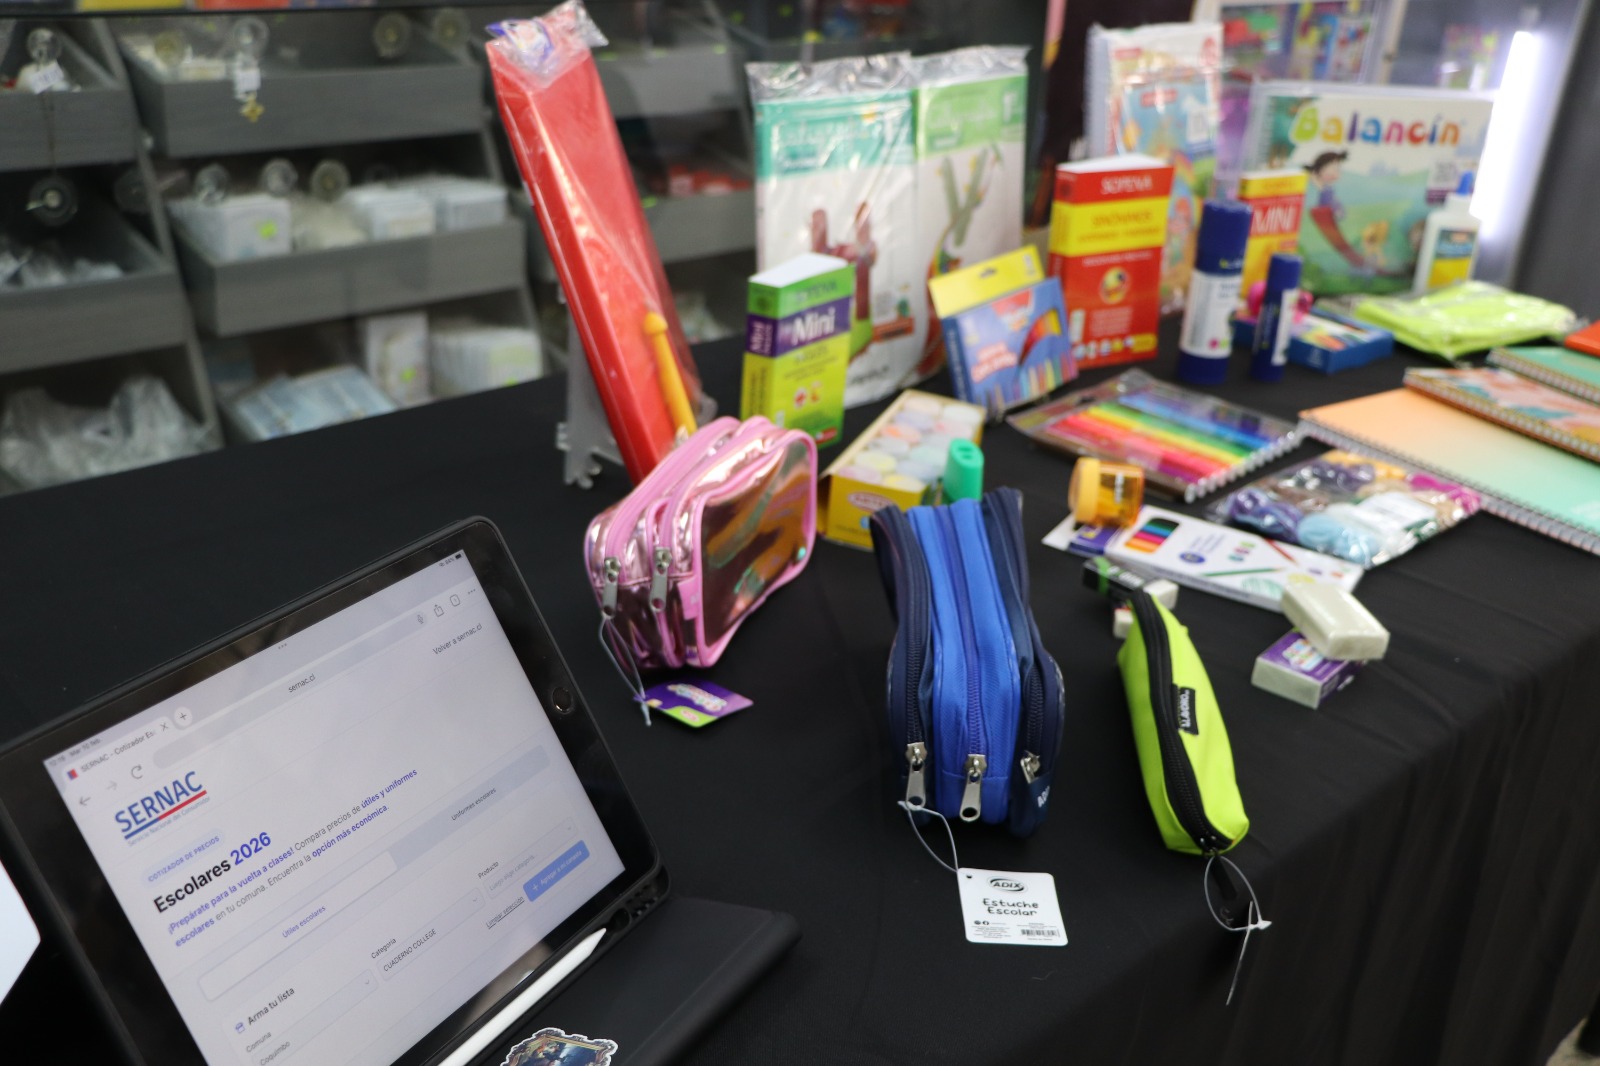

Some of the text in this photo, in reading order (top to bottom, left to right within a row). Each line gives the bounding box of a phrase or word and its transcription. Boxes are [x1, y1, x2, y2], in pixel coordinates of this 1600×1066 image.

[791, 307, 836, 346] Mini
[432, 640, 452, 655] Volver
[457, 623, 482, 642] sernac.cl
[288, 673, 316, 693] sernac.cl
[80, 753, 109, 773] SERNAC
[114, 734, 145, 756] Cotizador
[115, 771, 203, 833] SERNAC
[451, 788, 496, 821] Uniformes escolares
[148, 836, 220, 882] COTIZADOR DE PRECIOS
[168, 769, 418, 935] ¡Prepárate para la vuelta a clases! Compara precios de útiles y uniformes
[153, 832, 271, 914] Escolares 2026
[175, 804, 389, 947] escolares en tu comuna. Encuentra la opción más económica.
[478, 861, 499, 879] Producto
[993, 881, 1022, 889] ADIX
[299, 905, 326, 927] escolares
[503, 896, 524, 915] selección
[982, 897, 1039, 909] Estuche
[987, 906, 1038, 916] Escolar
[383, 928, 437, 972] CUADERNO COLLEGE
[247, 987, 295, 1026] Arma tu lista
[246, 1031, 272, 1053] Comuna
[260, 1041, 291, 1066] Coquimbo
